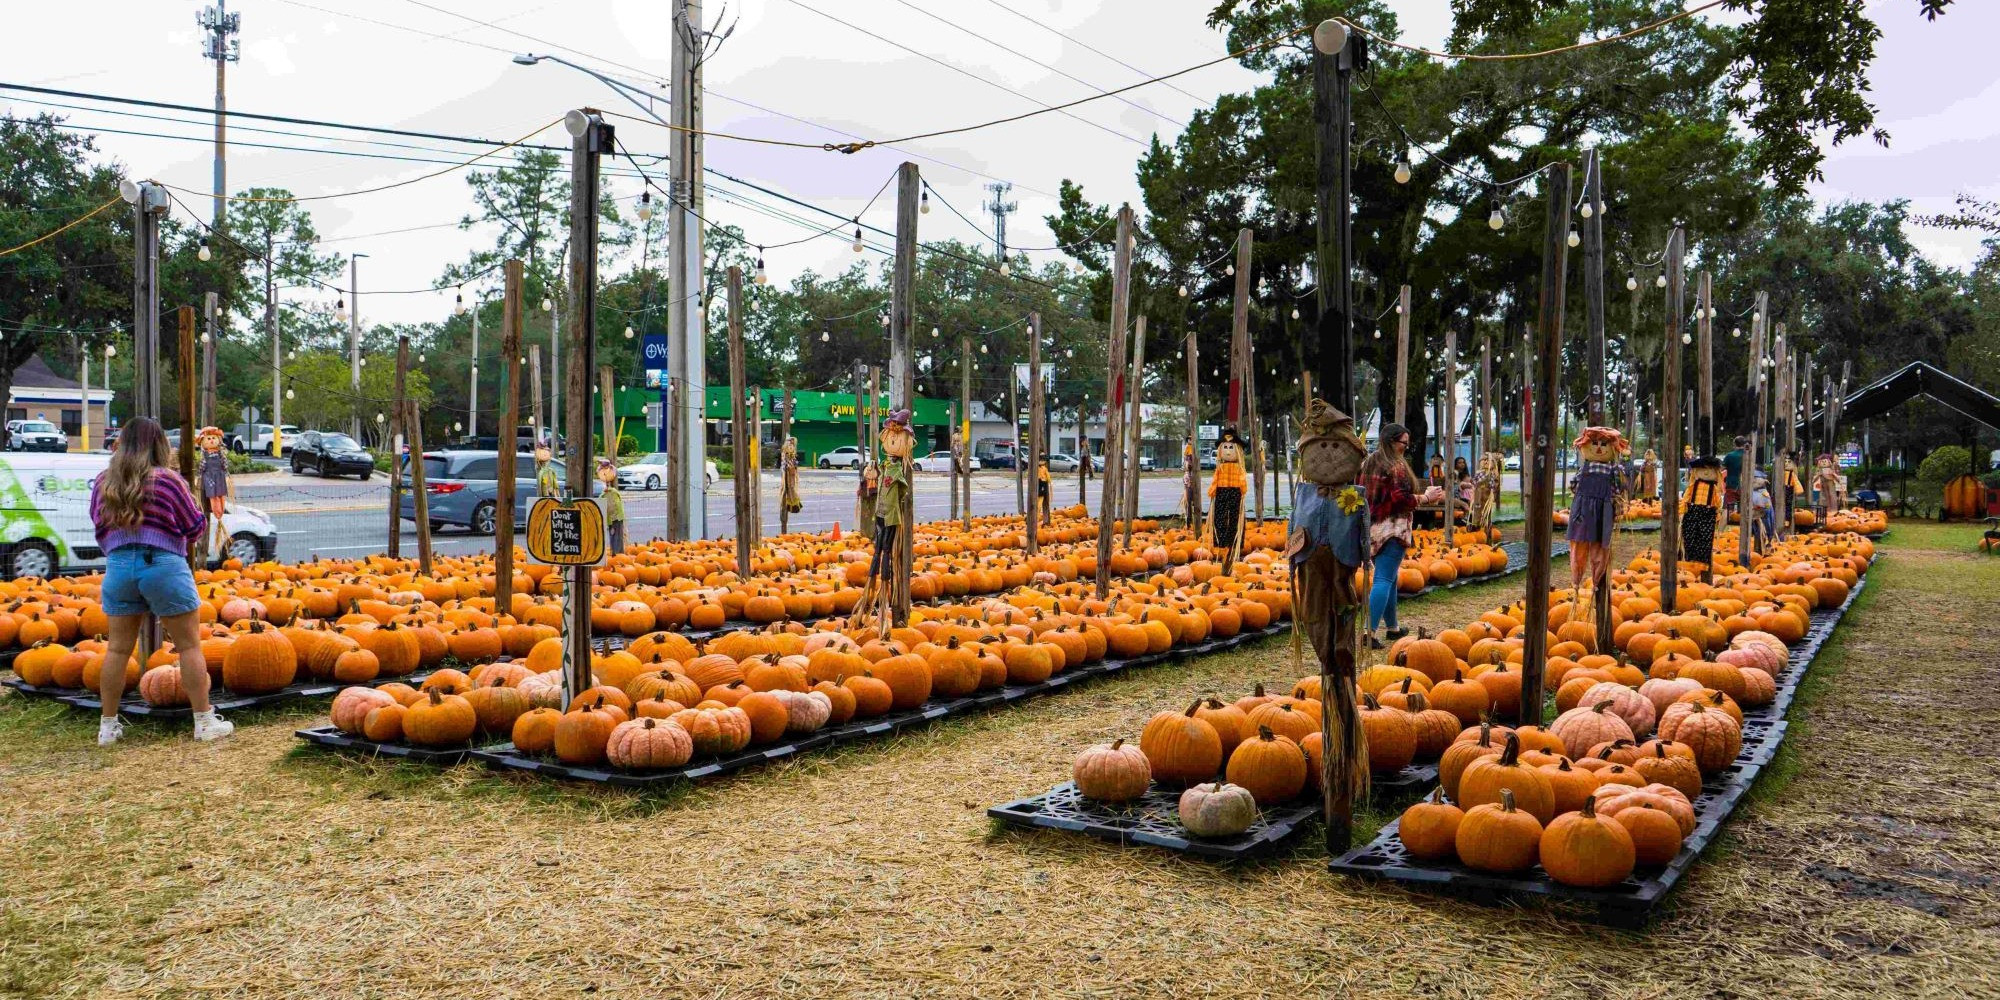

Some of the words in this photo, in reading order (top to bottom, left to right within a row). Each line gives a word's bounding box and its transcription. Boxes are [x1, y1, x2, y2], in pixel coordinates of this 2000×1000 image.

[564, 522, 575, 530] us
[553, 529, 563, 542] by
[564, 529, 580, 540] the
[554, 540, 580, 553] Stem
